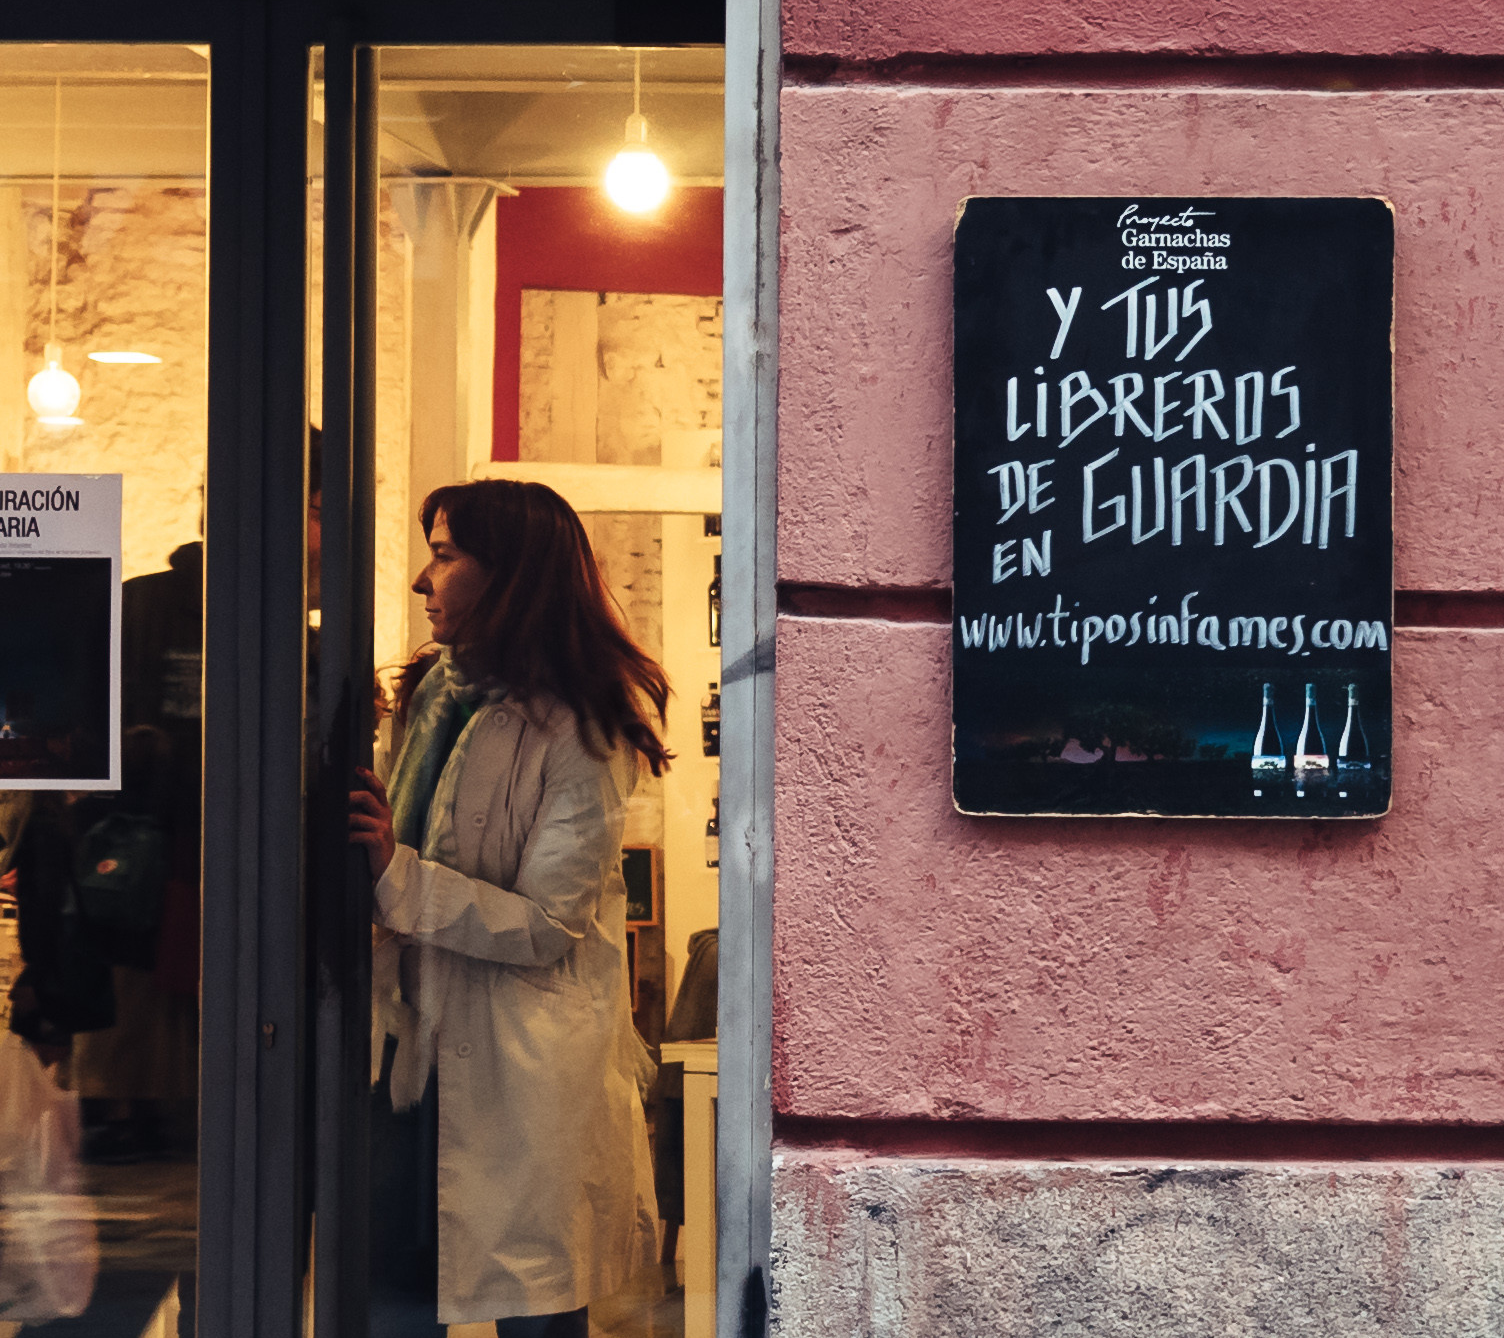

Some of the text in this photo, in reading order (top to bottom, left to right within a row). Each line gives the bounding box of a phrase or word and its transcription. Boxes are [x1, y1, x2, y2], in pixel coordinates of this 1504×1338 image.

[1117, 205, 1215, 229] Proyecto
[1122, 229, 1230, 248] Garnachas
[1122, 250, 1228, 274] de España
[1046, 276, 1213, 362] Y TUS
[987, 459, 1056, 525] DE
[992, 530, 1053, 583] EN
[960, 592, 1389, 665] www.tiposinfames.com
